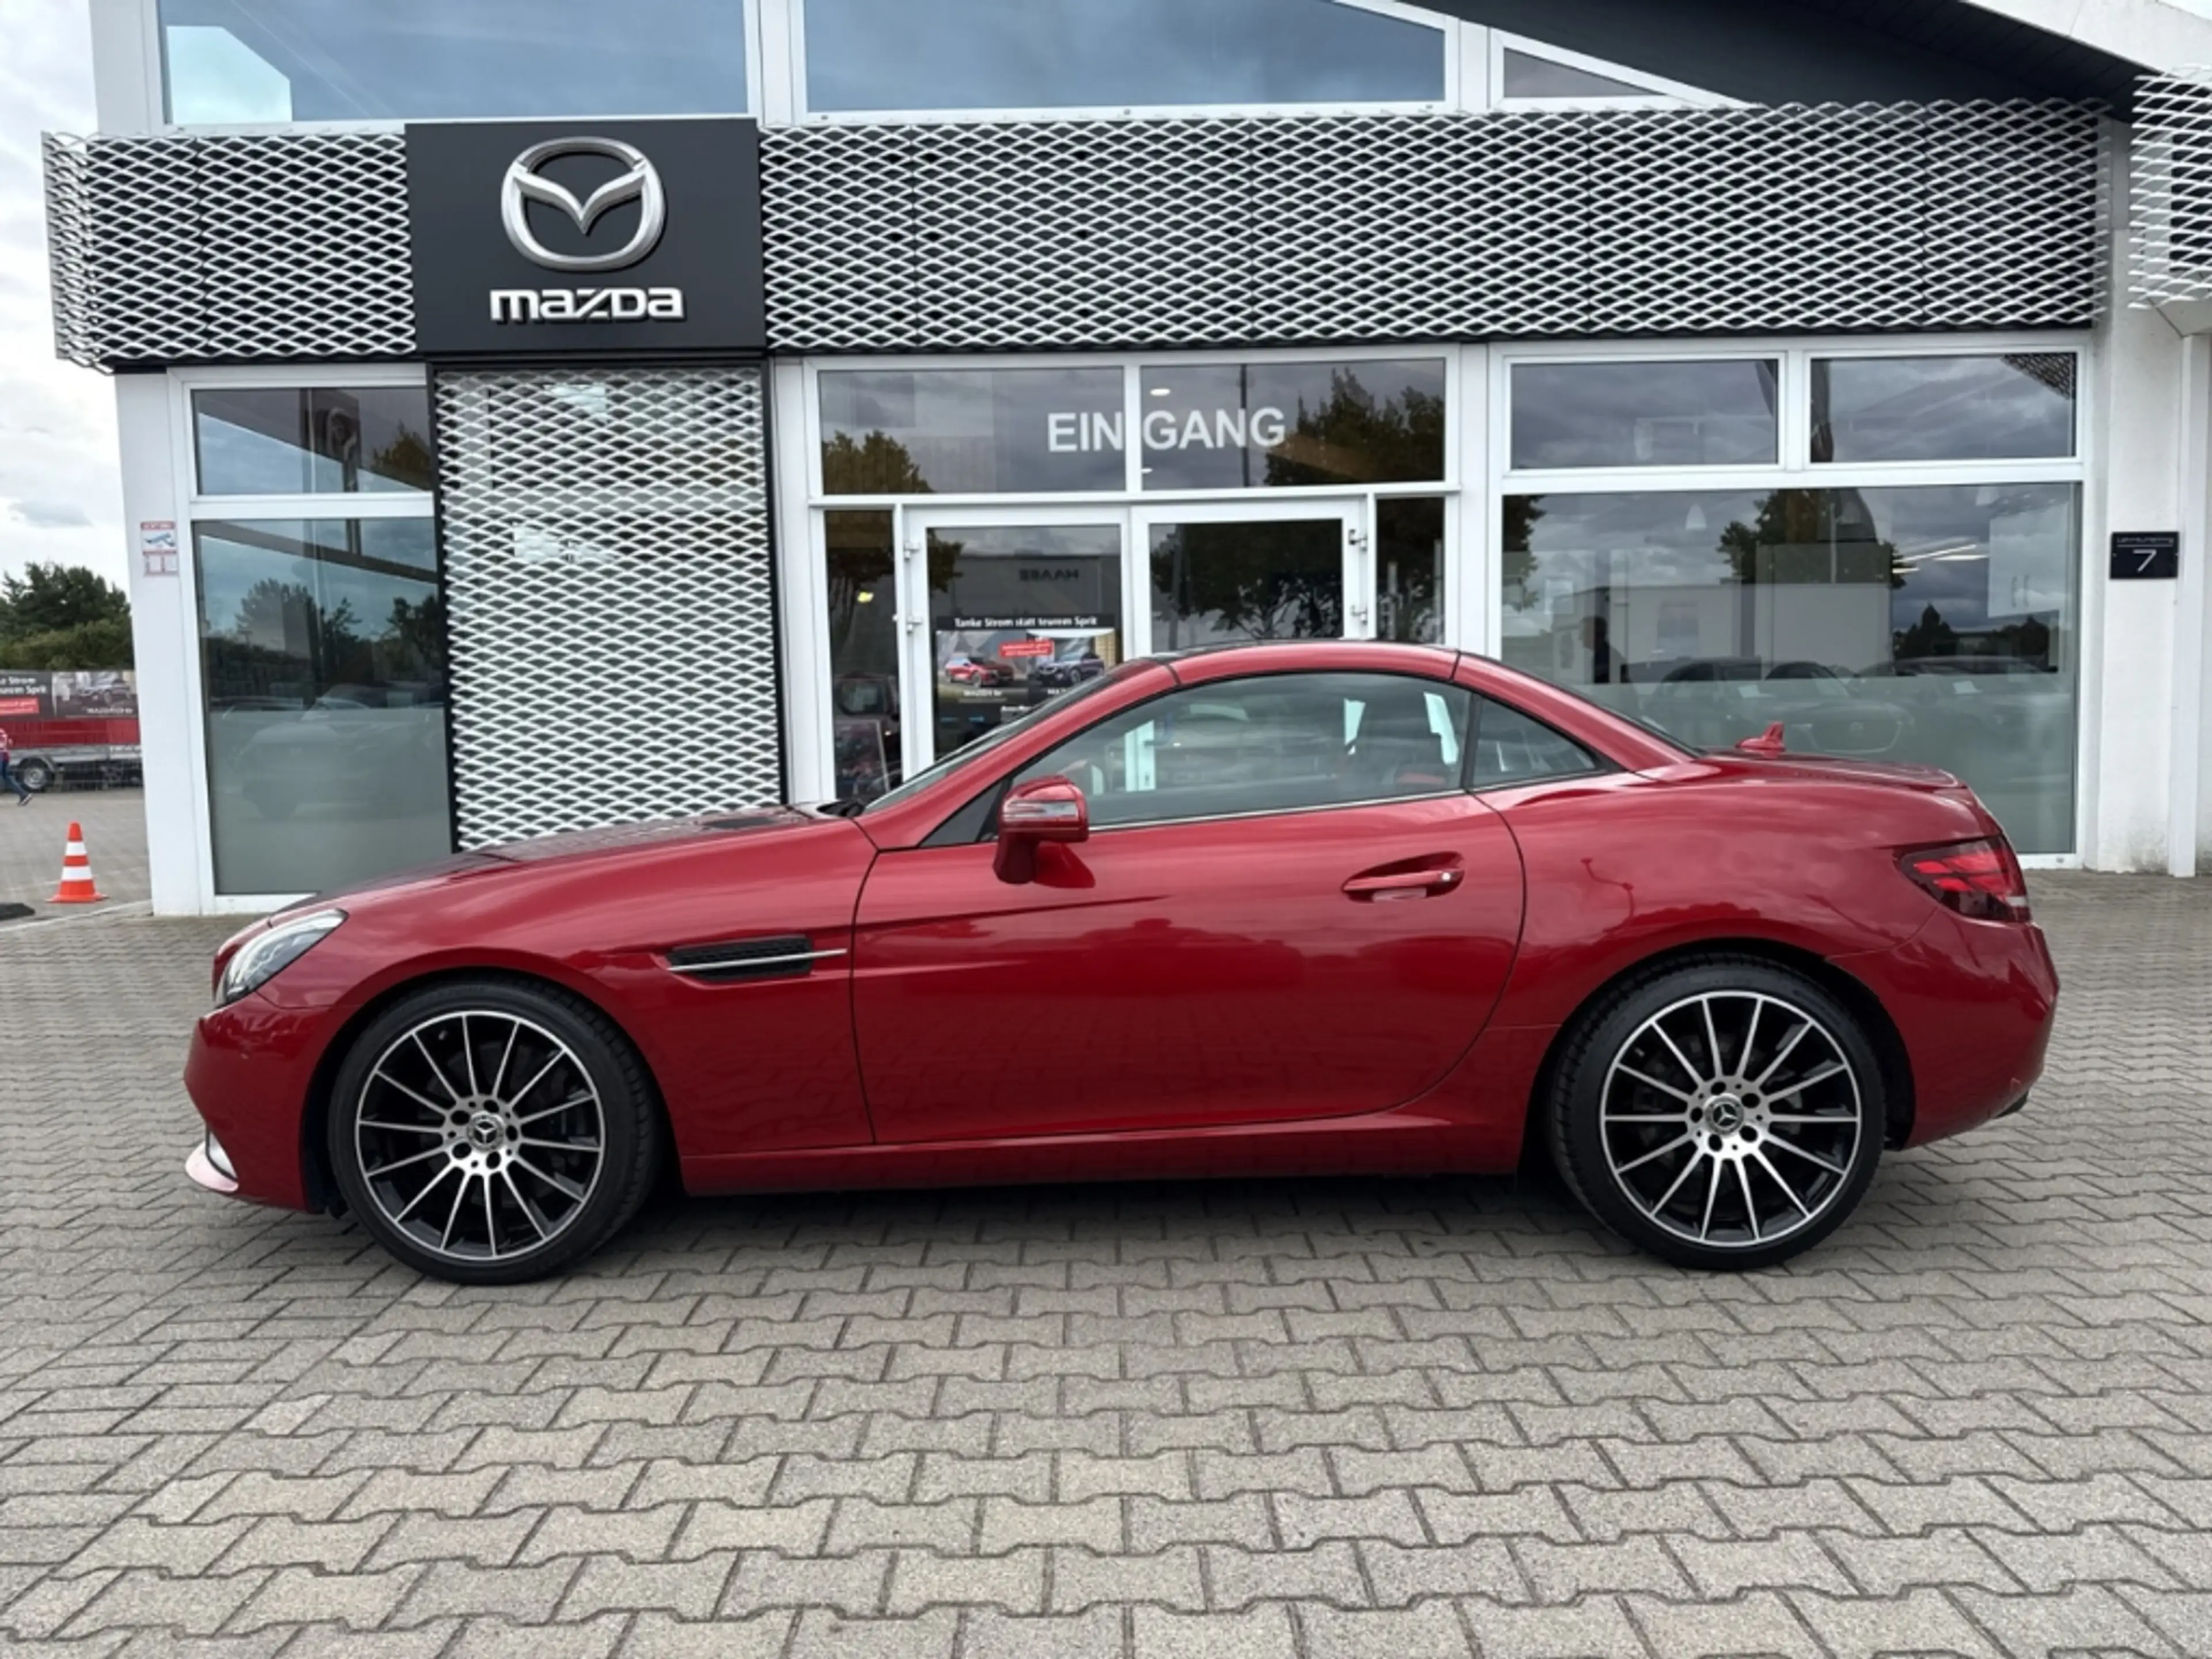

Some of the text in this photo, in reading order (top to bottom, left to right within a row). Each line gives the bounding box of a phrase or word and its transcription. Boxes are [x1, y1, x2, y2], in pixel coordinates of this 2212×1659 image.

[490, 287, 684, 321] mazda
[1047, 407, 1286, 452] EINGANG
[2133, 549, 2156, 572] 7
[984, 618, 1014, 627] Strom
